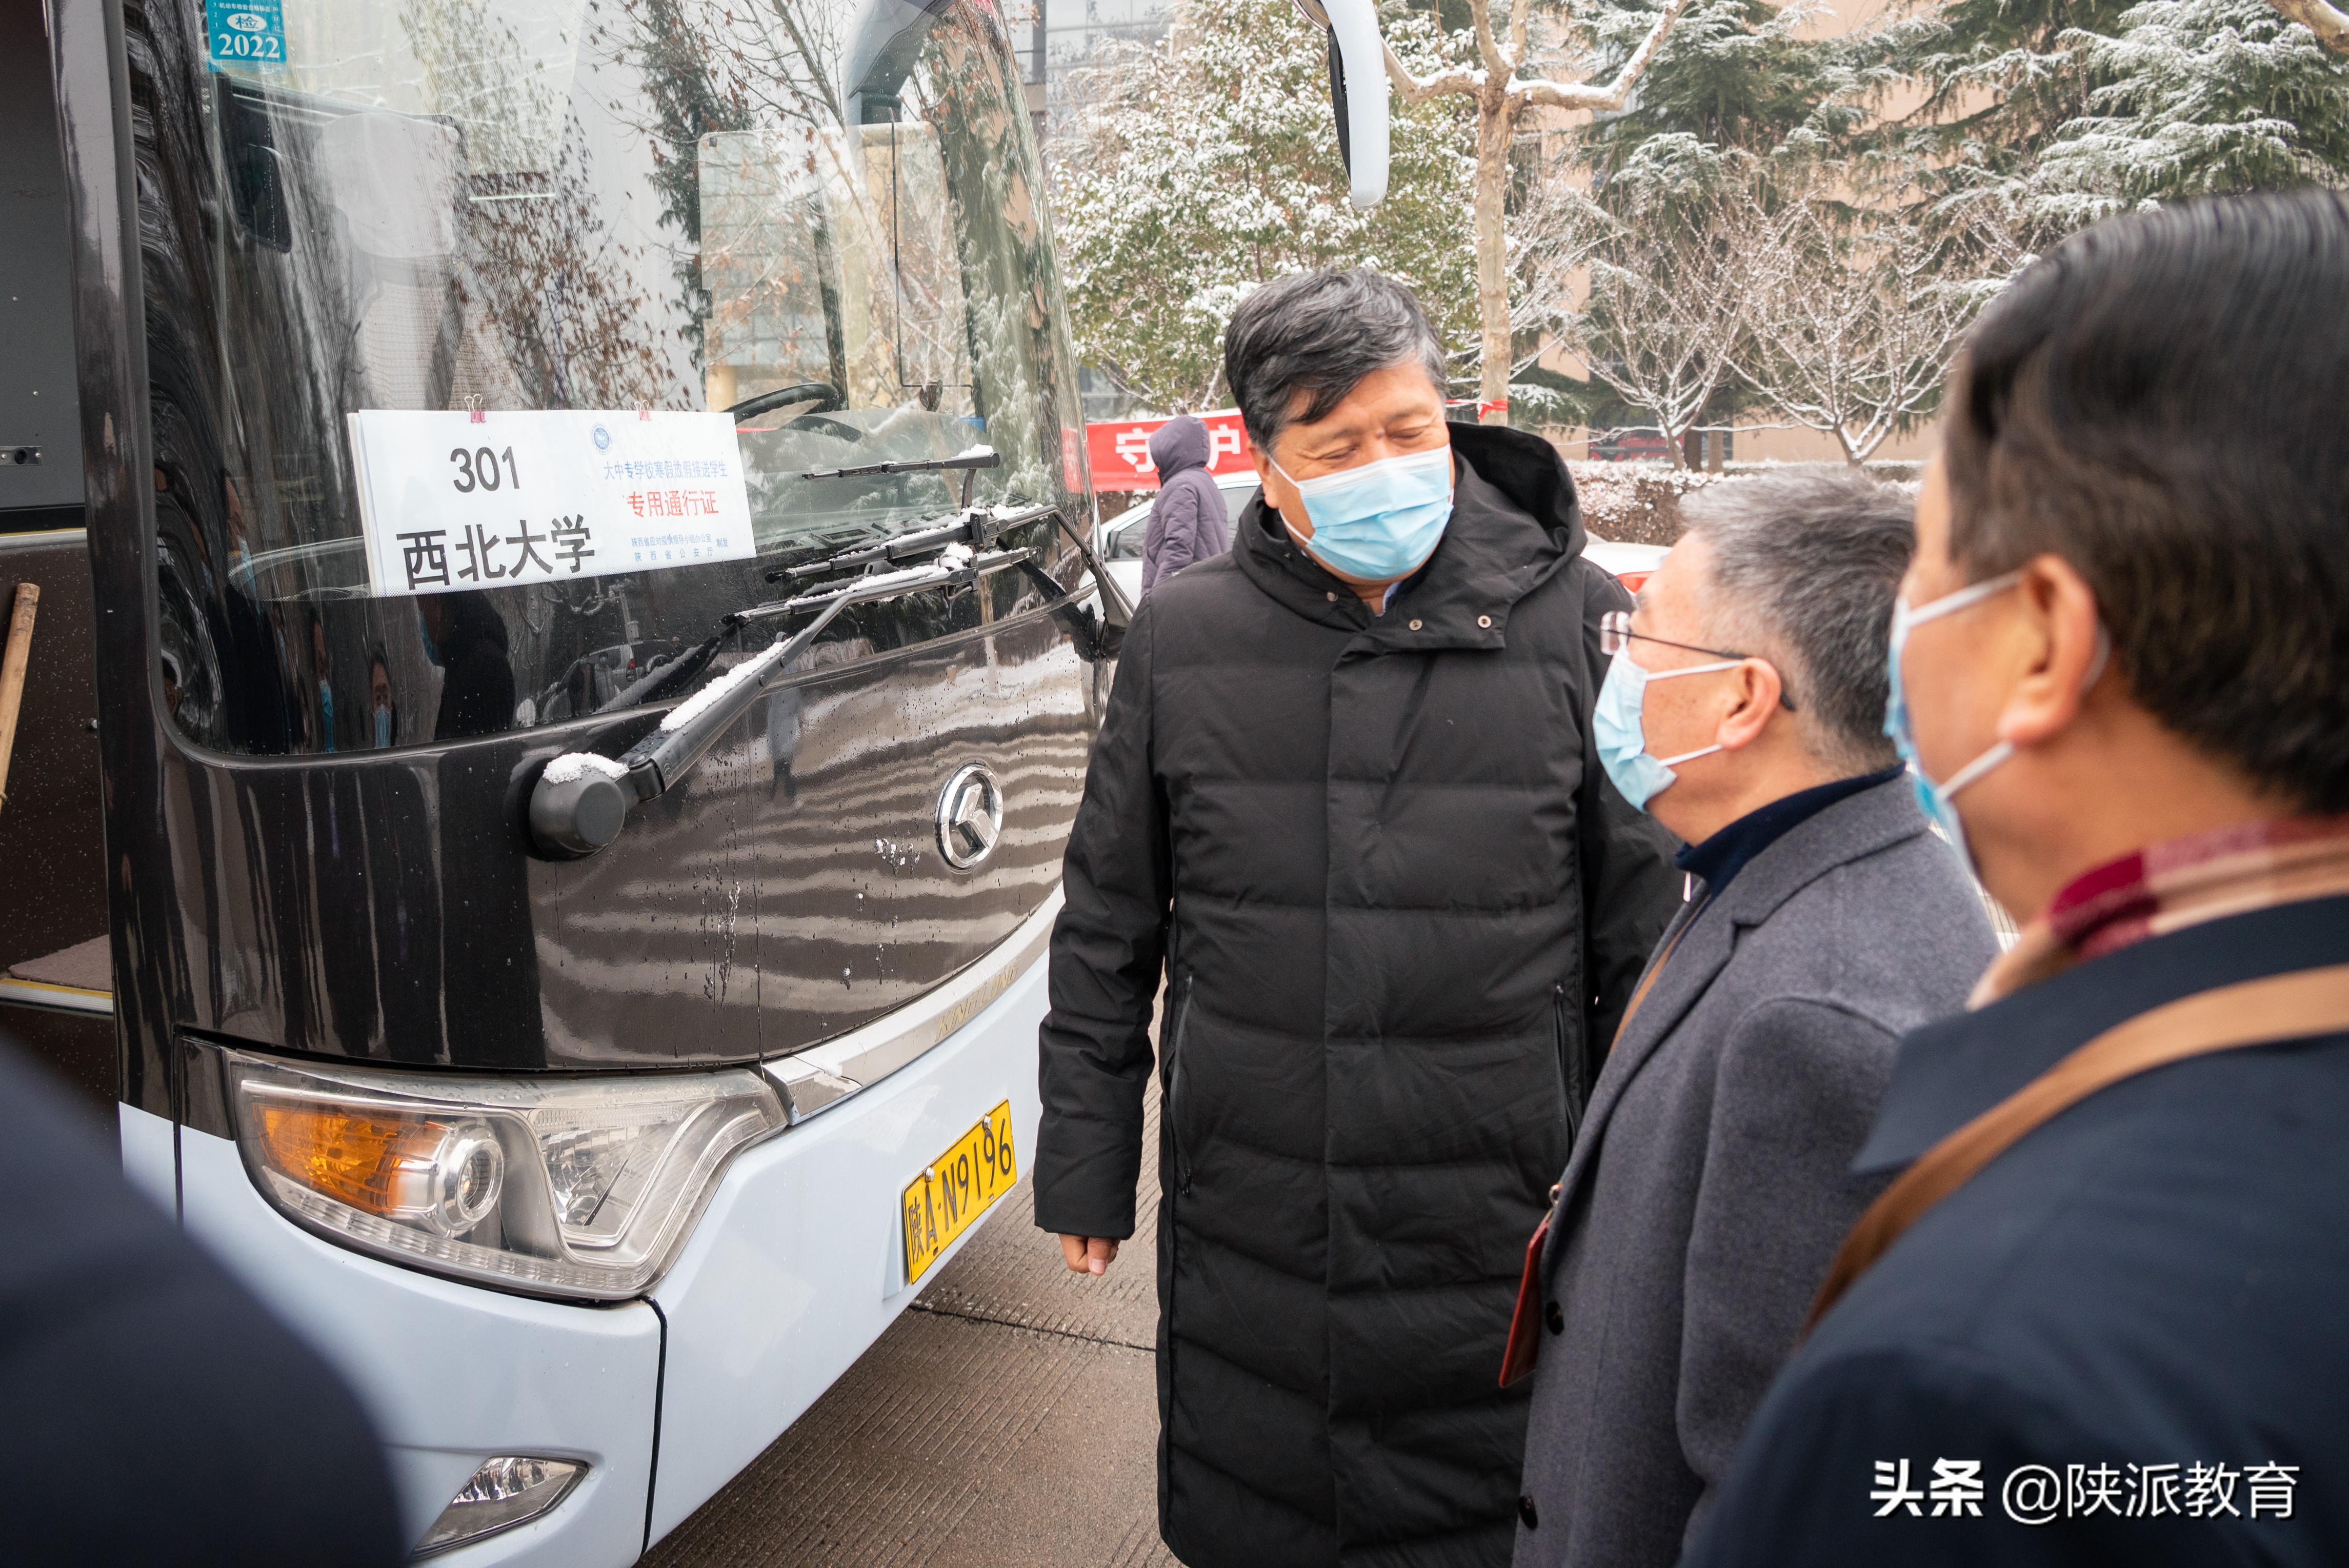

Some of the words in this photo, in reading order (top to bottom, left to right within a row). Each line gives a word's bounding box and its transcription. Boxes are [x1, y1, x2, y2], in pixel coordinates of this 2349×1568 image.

[235, 16, 259, 29] 检
[218, 33, 280, 58] 2022
[450, 446, 520, 493] 301
[604, 460, 728, 480] 大中专学校寒假放假接送学生
[627, 490, 719, 517] 专用通行证
[396, 514, 595, 590] 西北大学
[716, 538, 728, 548] 制发
[935, 990, 979, 1042] KING
[980, 956, 1020, 1009] LONG
